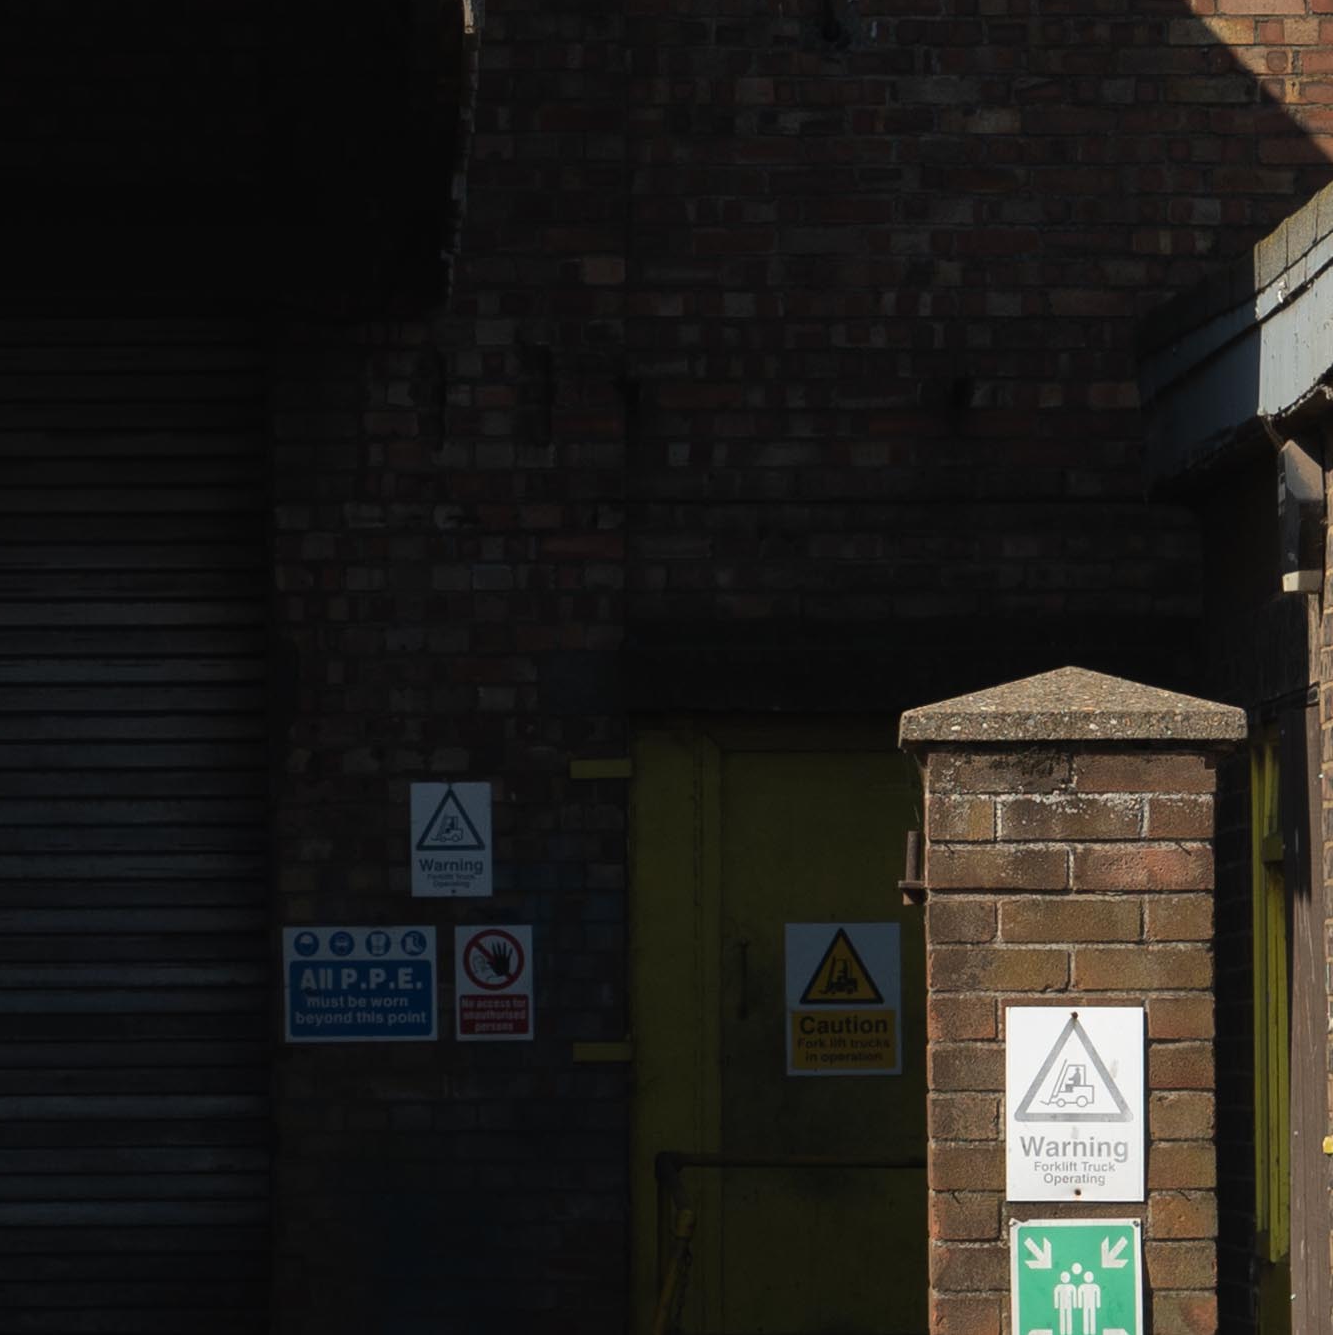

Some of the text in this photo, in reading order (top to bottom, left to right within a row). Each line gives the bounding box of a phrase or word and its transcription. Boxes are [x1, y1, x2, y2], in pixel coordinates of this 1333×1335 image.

[419, 858, 483, 874] Warning
[300, 967, 423, 990] All P.P.E.
[307, 995, 408, 1008] must be worn
[295, 1012, 427, 1027] beyond this point
[800, 1016, 888, 1035] Caution
[798, 1037, 890, 1049] Fork lift trucks
[805, 1051, 883, 1065] in operation
[1019, 1136, 1129, 1162] Warning
[1034, 1161, 1116, 1172] Forklift Truck
[1043, 1173, 1106, 1186] Operating
